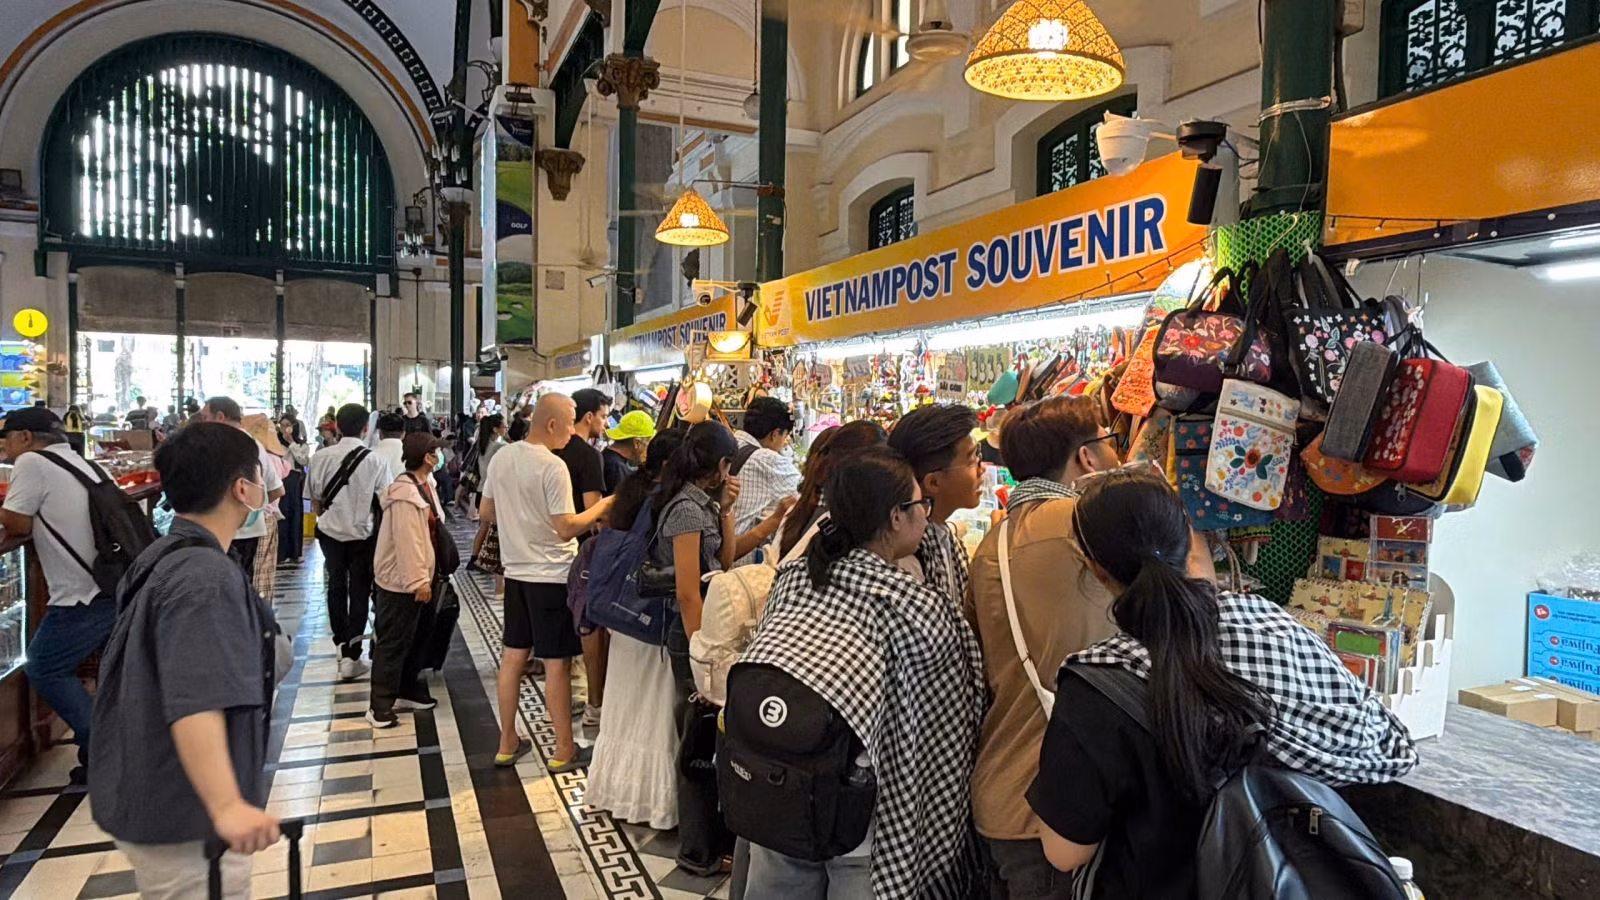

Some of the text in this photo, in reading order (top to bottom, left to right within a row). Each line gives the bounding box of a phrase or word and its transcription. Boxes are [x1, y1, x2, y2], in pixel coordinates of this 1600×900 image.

[805, 197, 1165, 322] VIETNAMPOST SOUVENIR
[679, 312, 727, 346] SOUVENIR
[767, 702, 782, 722] 3
